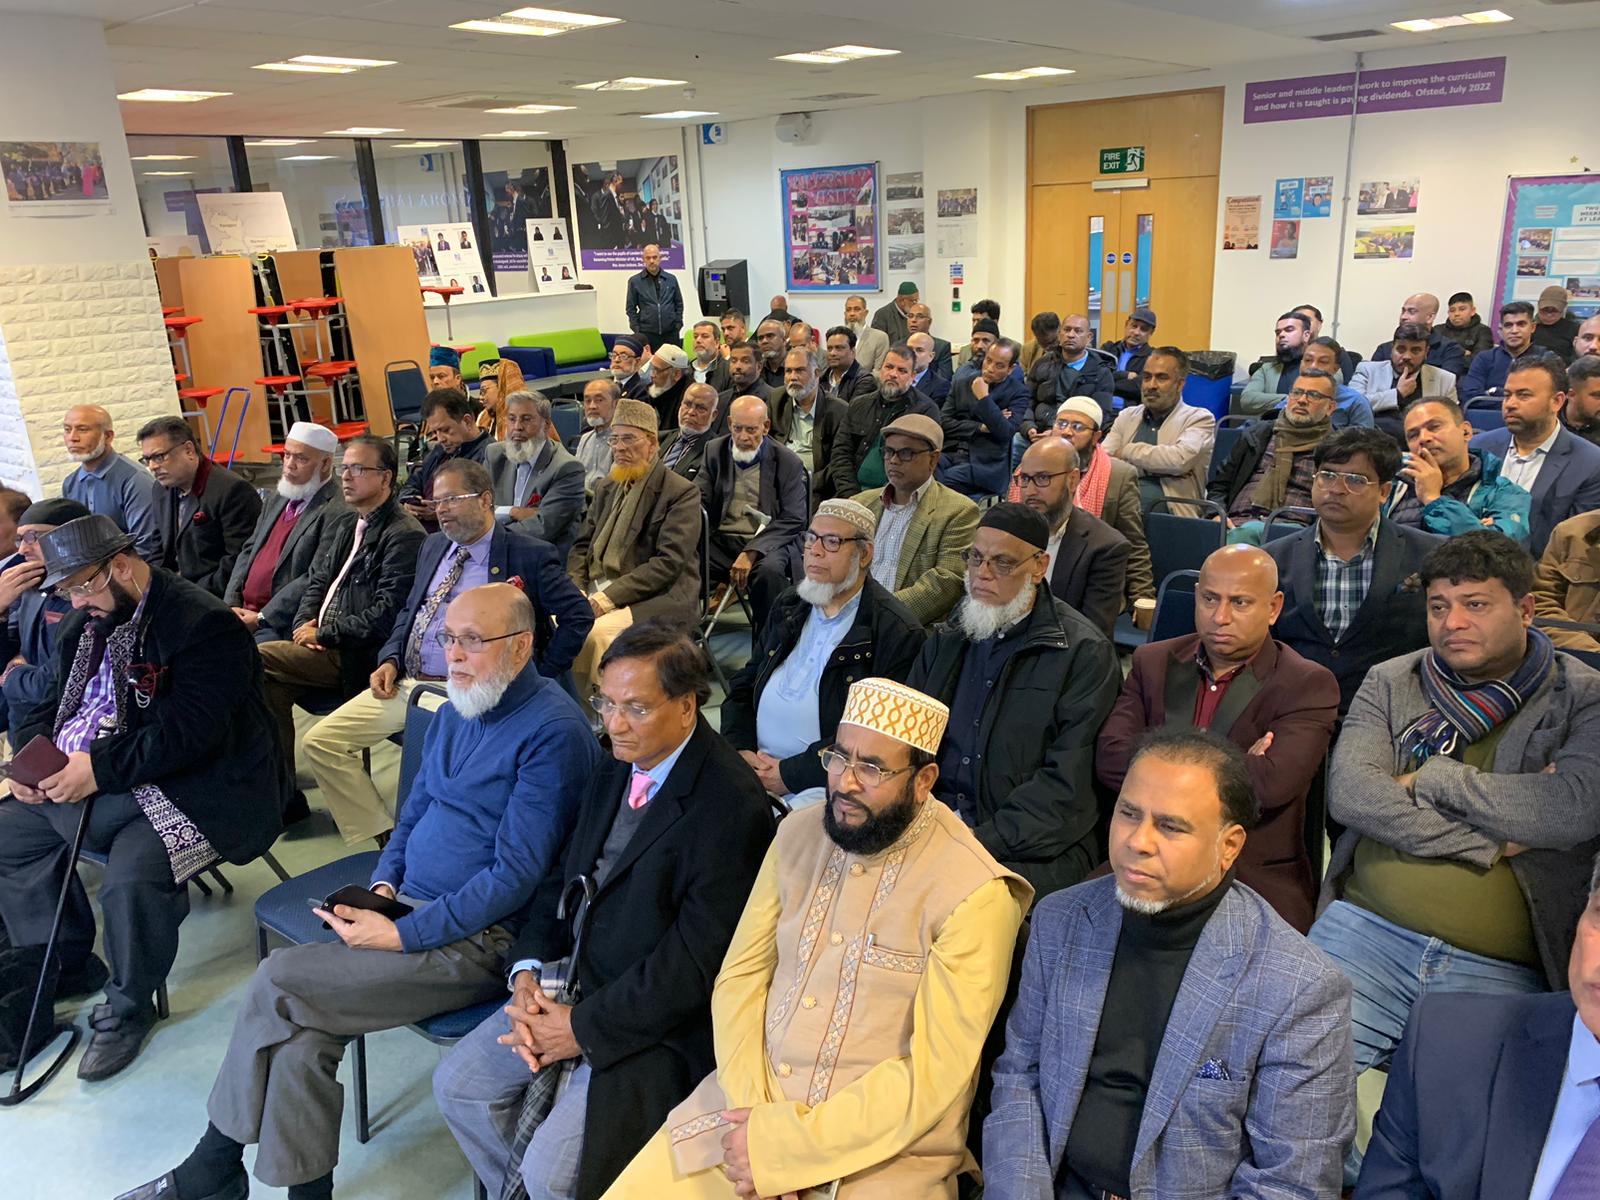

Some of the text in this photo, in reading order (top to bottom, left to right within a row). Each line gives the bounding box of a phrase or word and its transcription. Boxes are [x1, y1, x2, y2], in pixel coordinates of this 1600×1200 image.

[1253, 92, 1277, 100] Senior
[1278, 89, 1294, 98] and
[1295, 87, 1322, 96] middle
[1359, 80, 1380, 90] work
[1392, 78, 1429, 87] improve
[1430, 75, 1445, 83] the
[1447, 70, 1496, 82] curriculum
[1254, 103, 1269, 111] and
[1270, 101, 1287, 110] how
[1289, 100, 1295, 108] it
[1297, 100, 1303, 108] is
[1304, 98, 1331, 107] taught
[1333, 97, 1339, 105] is
[1340, 95, 1368, 105] payng
[1415, 85, 1448, 96] Ofsted,
[1448, 83, 1467, 94] July
[1468, 83, 1492, 92] 2022
[1104, 152, 1120, 160] FIRE
[1104, 161, 1120, 170] EXIT
